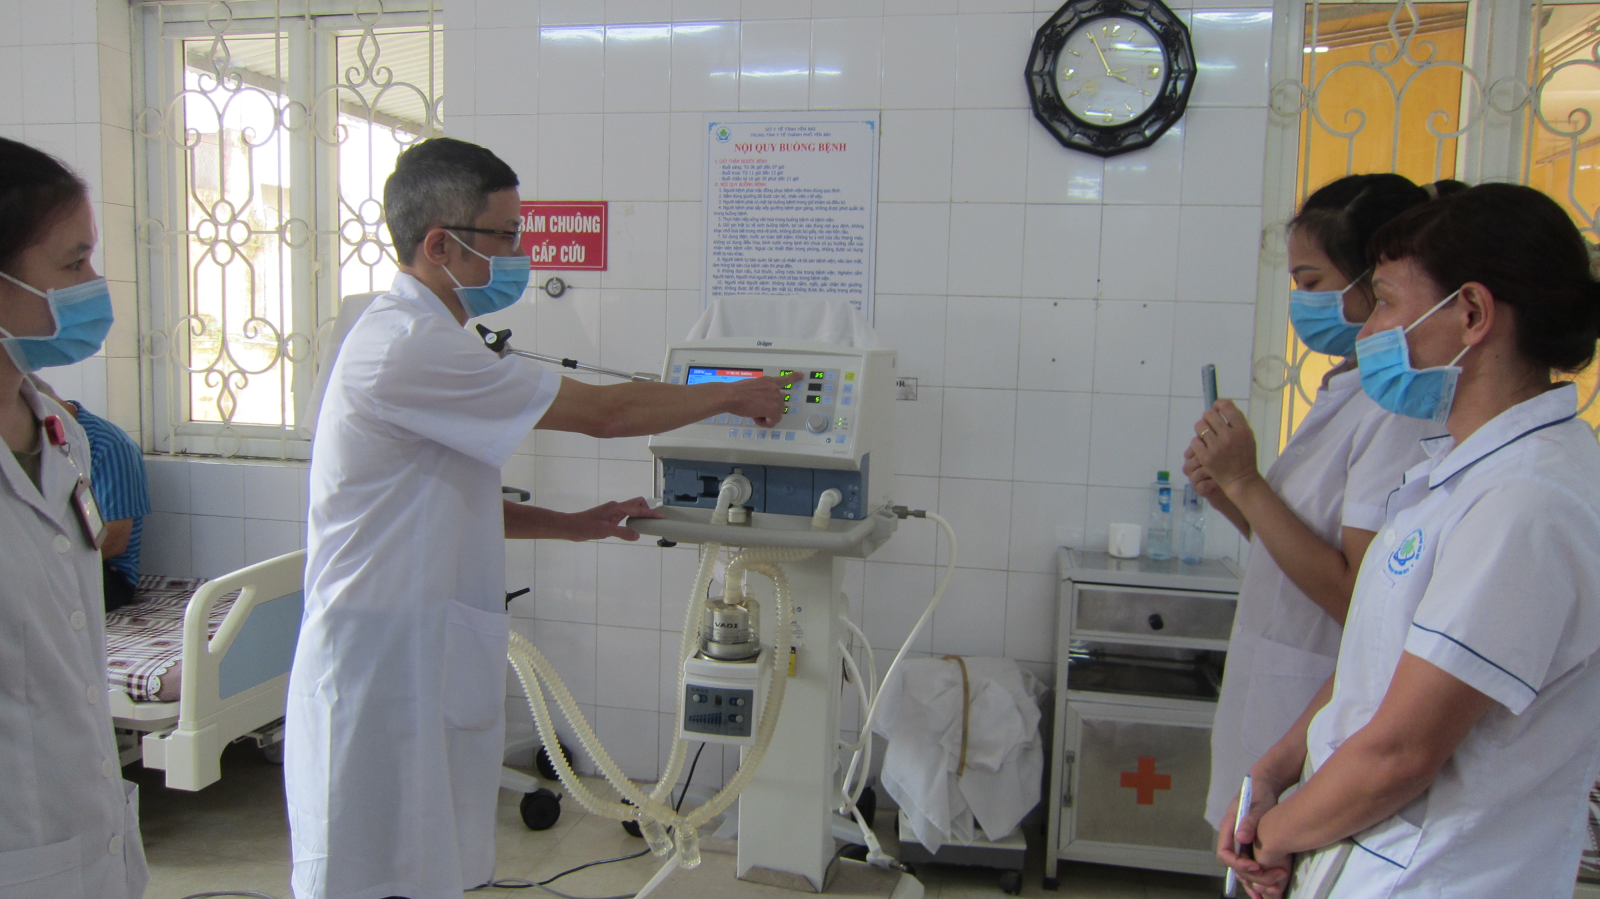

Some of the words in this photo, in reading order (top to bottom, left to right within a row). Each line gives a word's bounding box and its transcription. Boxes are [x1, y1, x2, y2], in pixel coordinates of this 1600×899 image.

[735, 142, 753, 154] NỘI
[755, 143, 777, 154] QUY
[779, 141, 815, 152] BUỒNG
[818, 142, 847, 154] BỆNH
[518, 209, 546, 233] BẤM
[549, 212, 601, 233] CHUÔNG
[531, 239, 557, 263] CẤP
[560, 240, 586, 263] CỨU
